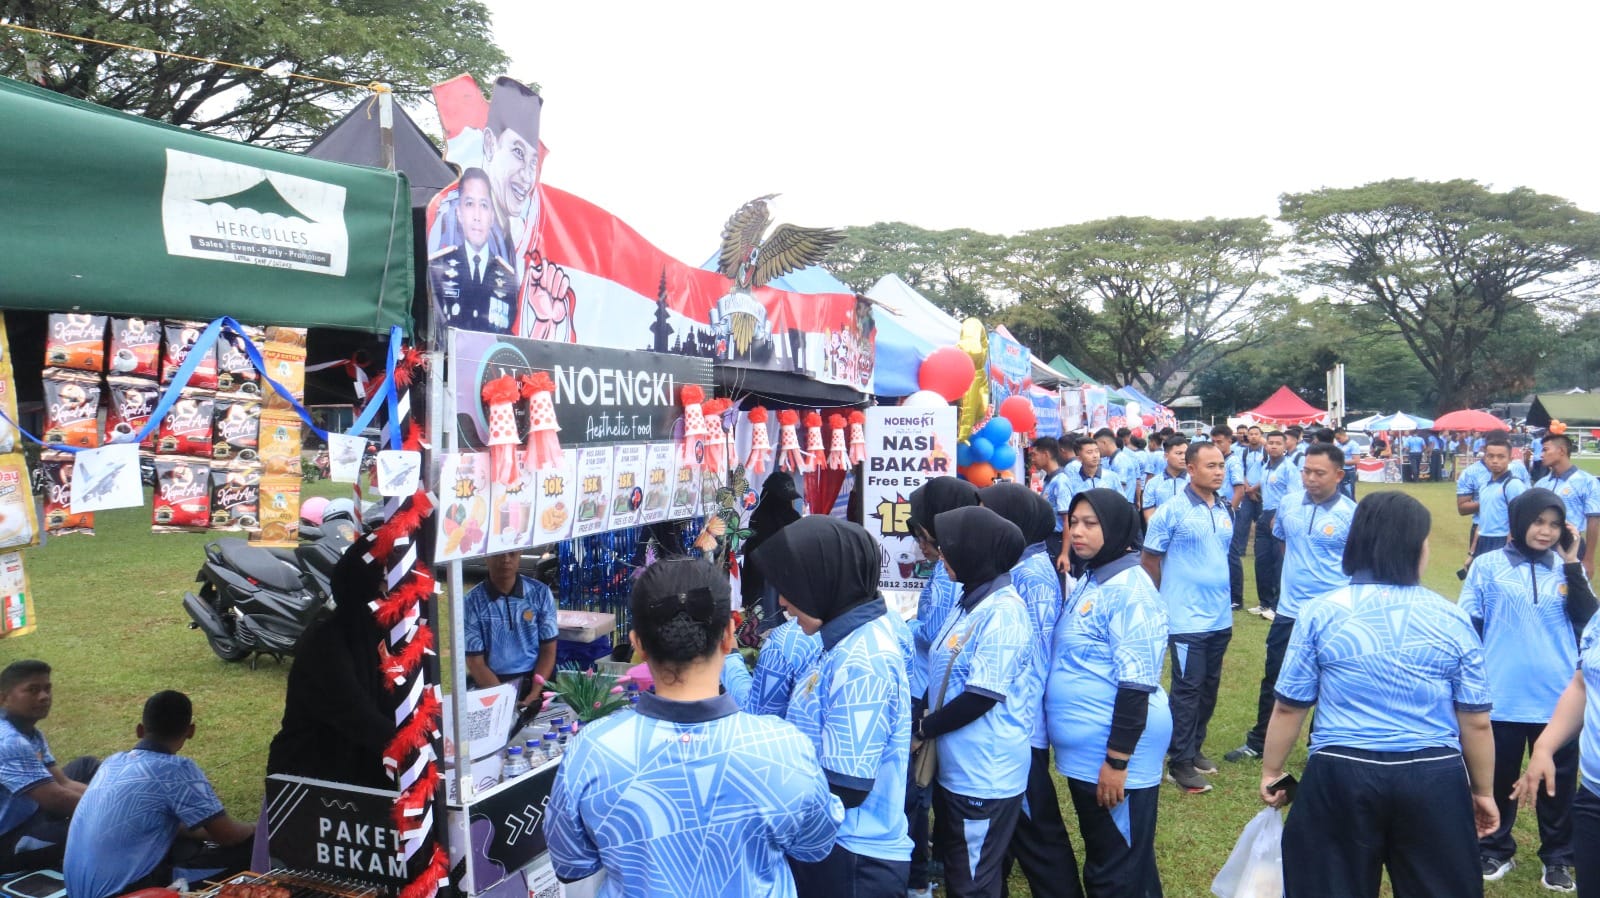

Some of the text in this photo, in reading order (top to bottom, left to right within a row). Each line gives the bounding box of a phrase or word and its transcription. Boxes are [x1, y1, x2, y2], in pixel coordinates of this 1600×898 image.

[216, 220, 308, 245] HERCULLES
[198, 238, 224, 249] Sales
[231, 243, 256, 252] Event
[262, 246, 283, 258] Party
[288, 250, 326, 262] Promotion
[554, 365, 675, 407] NOENGKI
[586, 411, 653, 441] Aesthetic Food
[884, 411, 935, 428] NOENGKI
[882, 436, 935, 451] NASI
[870, 456, 948, 472] BAKAR
[456, 479, 473, 497] 5K
[544, 478, 563, 496] 10K
[584, 477, 599, 494] 15K
[619, 473, 633, 488] 15K
[868, 476, 899, 487] Free
[903, 477, 921, 487] Es
[878, 581, 924, 589] 0812 3521
[319, 817, 401, 851] PAKET
[317, 842, 408, 879] BEKAM
